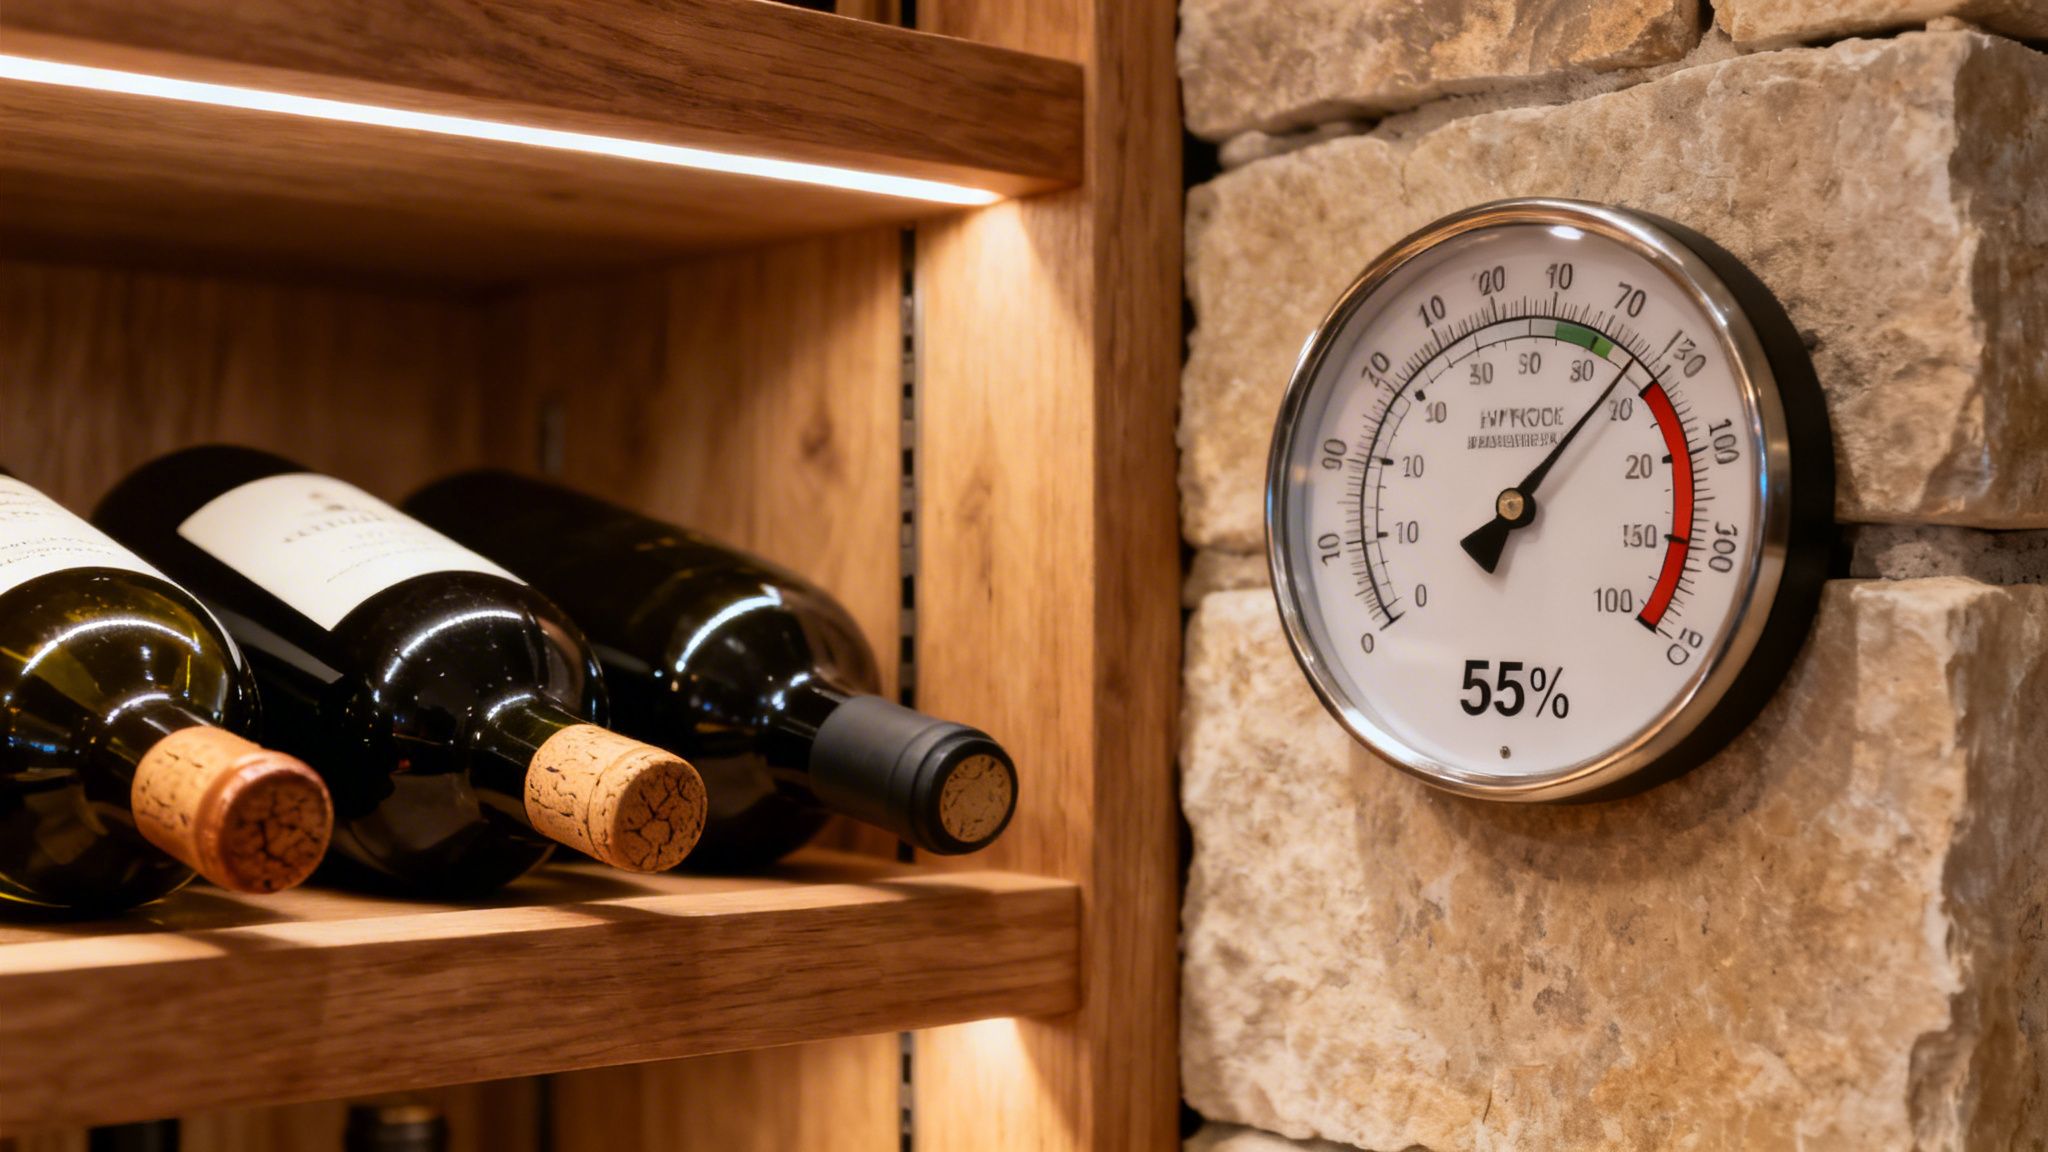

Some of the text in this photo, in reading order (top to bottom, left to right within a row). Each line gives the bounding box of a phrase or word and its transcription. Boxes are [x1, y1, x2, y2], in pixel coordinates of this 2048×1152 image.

[1418, 294, 1446, 328] 10
[1614, 281, 1647, 318] 70
[1625, 454, 1653, 480] 20
[1395, 520, 1419, 544] 10
[1317, 532, 1341, 566] 10
[1415, 583, 1427, 608] 0
[1594, 587, 1633, 613] 100
[1360, 632, 1375, 654] 0
[1460, 659, 1569, 719] 55%
